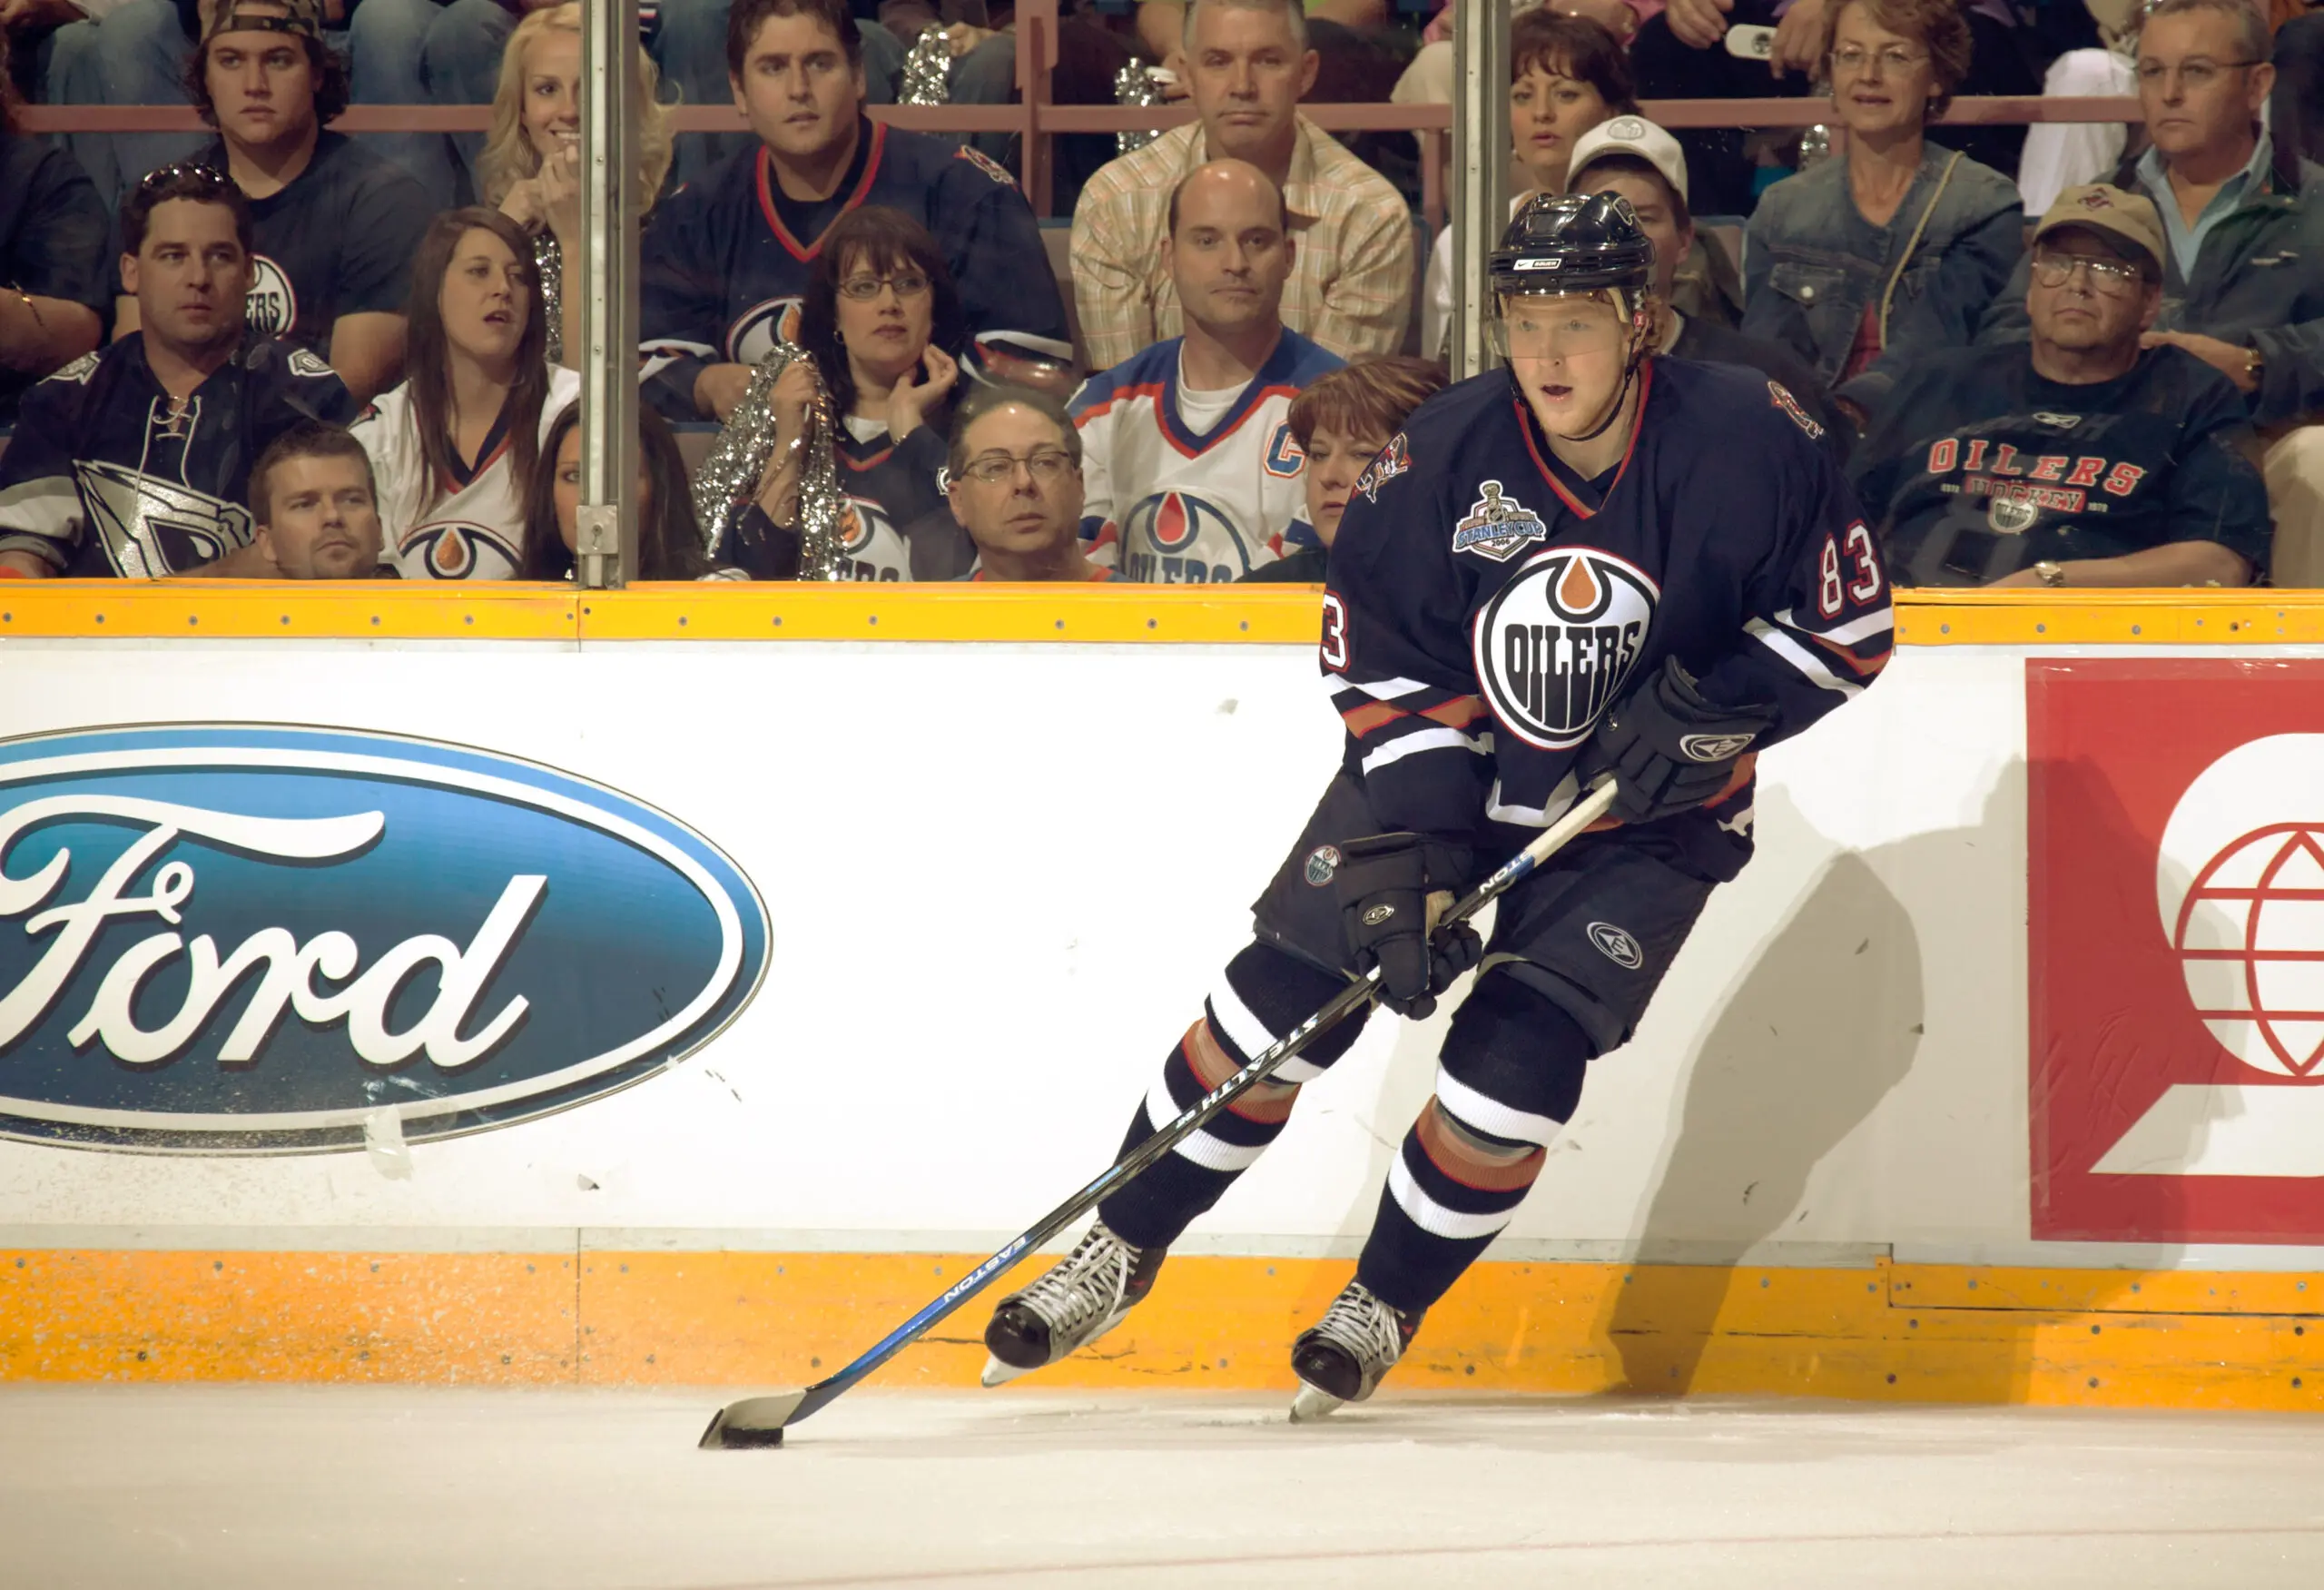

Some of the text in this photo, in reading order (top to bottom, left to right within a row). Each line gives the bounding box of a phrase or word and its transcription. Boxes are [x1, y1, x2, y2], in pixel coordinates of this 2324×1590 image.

[1928, 438, 2145, 497] OILERS
[1972, 478, 2081, 512] HOCKEY
[1456, 521, 1514, 548] STANLEY
[1513, 520, 1544, 538] CUP
[1492, 538, 1511, 547] 2006
[1818, 518, 1883, 620] 83
[1504, 620, 1641, 730] OILERS
[0, 795, 547, 1068] Ford
[1201, 1012, 1319, 1111] STEALTH
[942, 1235, 1028, 1304] EASTON
